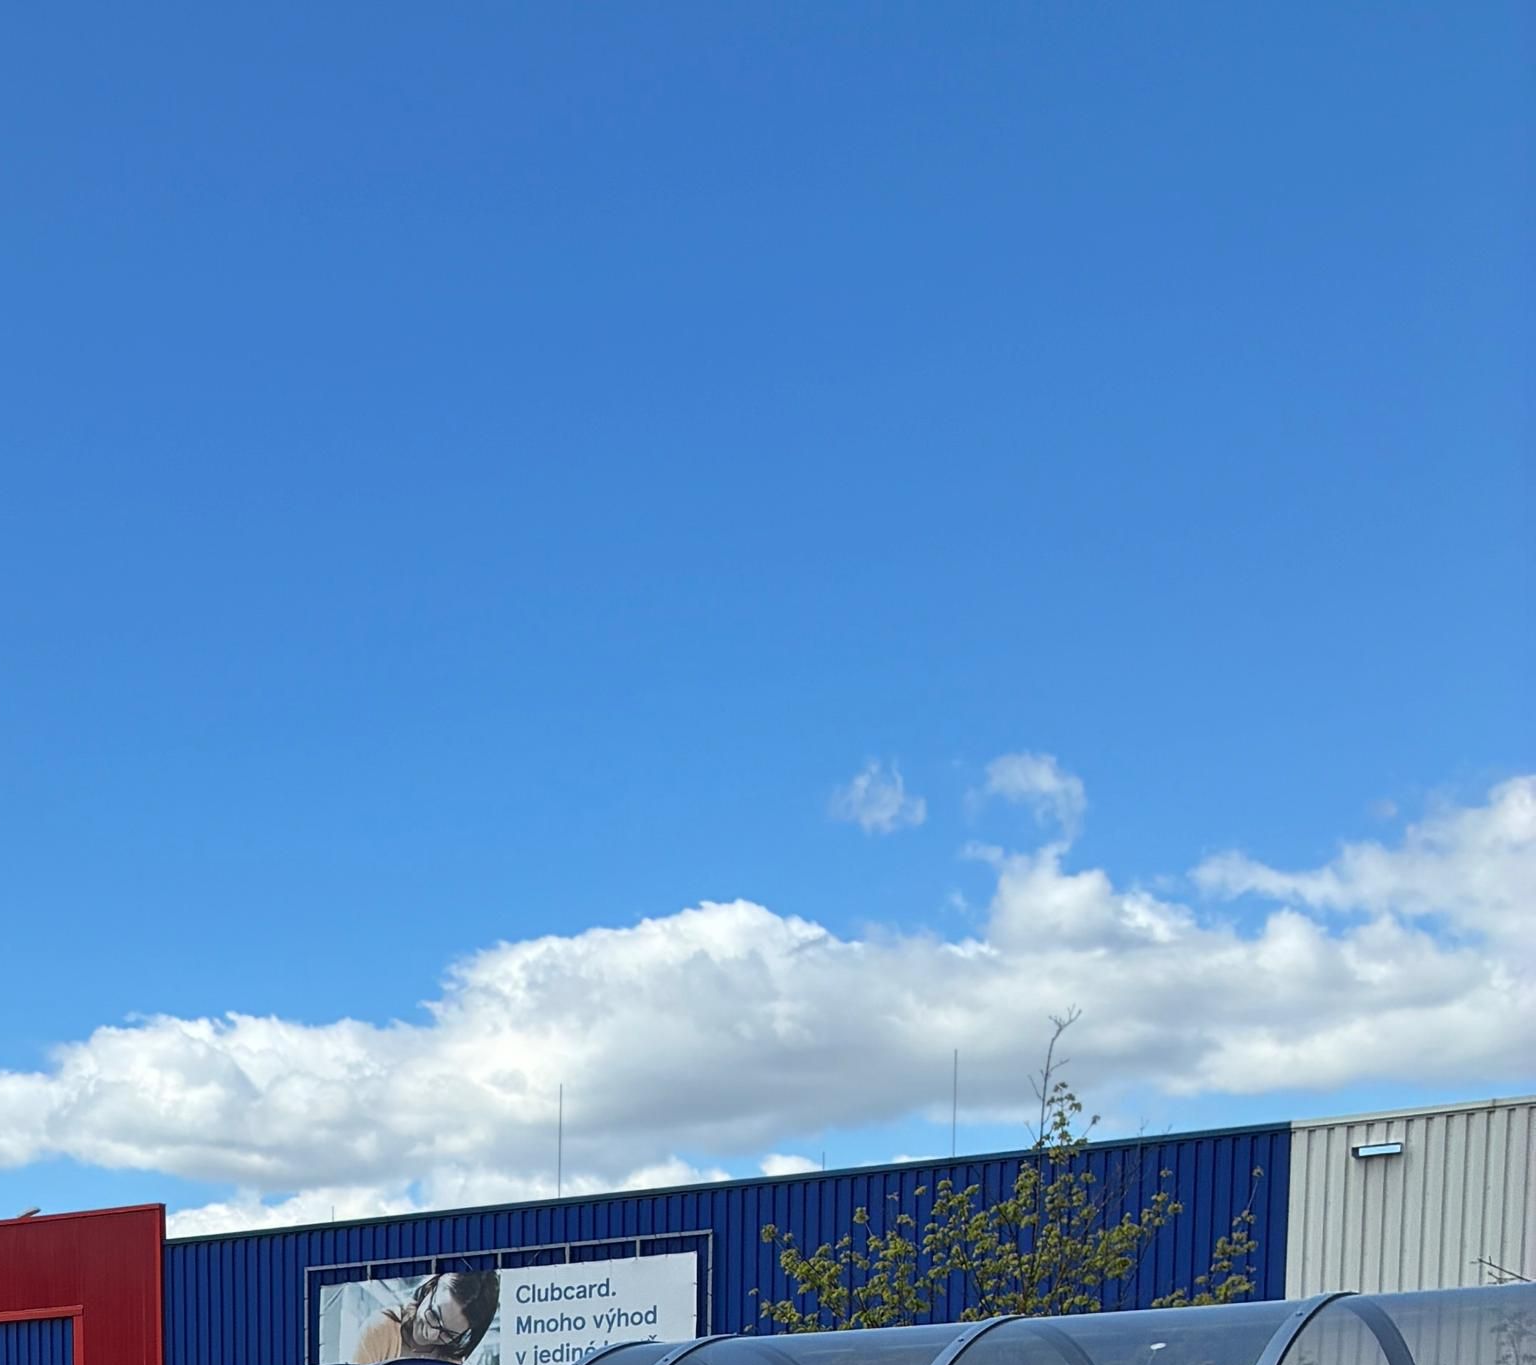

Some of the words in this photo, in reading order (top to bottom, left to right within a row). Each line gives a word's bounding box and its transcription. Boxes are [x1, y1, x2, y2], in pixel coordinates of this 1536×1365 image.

[516, 1278, 616, 1303] Clubcard.
[516, 1313, 586, 1335] Mnoho
[593, 1305, 657, 1333] výhod
[516, 1351, 526, 1365] v
